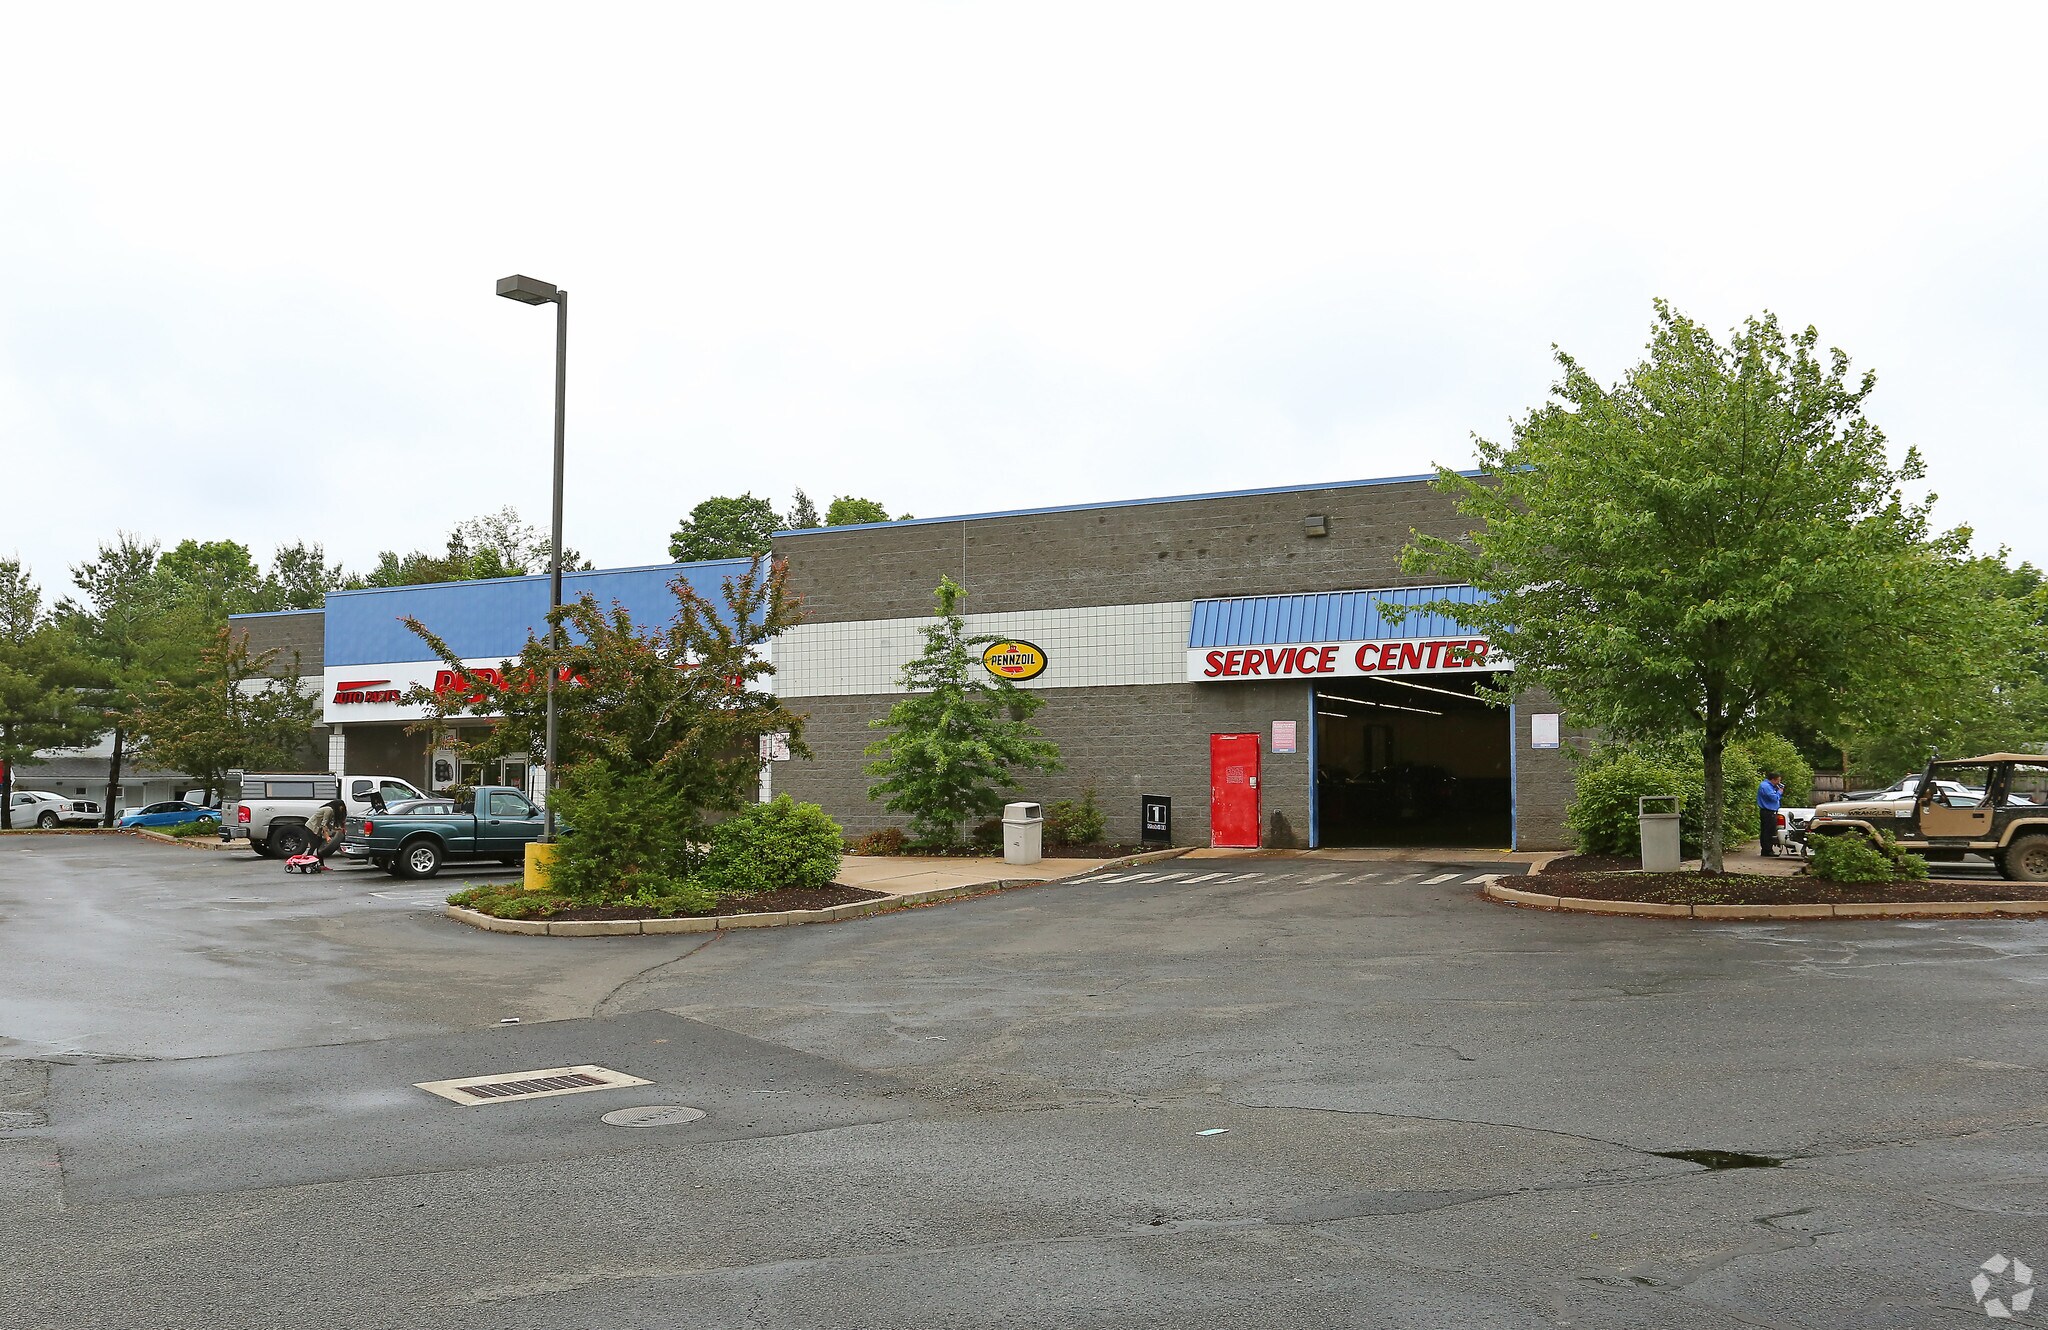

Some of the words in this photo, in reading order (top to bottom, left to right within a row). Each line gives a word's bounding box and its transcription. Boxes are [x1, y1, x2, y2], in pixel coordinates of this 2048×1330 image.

[991, 654, 1035, 666] PENNZOIL
[1203, 646, 1340, 678] SERVICE
[1355, 640, 1489, 672] CENTER
[333, 691, 364, 704] AUTO
[364, 689, 401, 703] PARTS
[1152, 806, 1160, 822] 1
